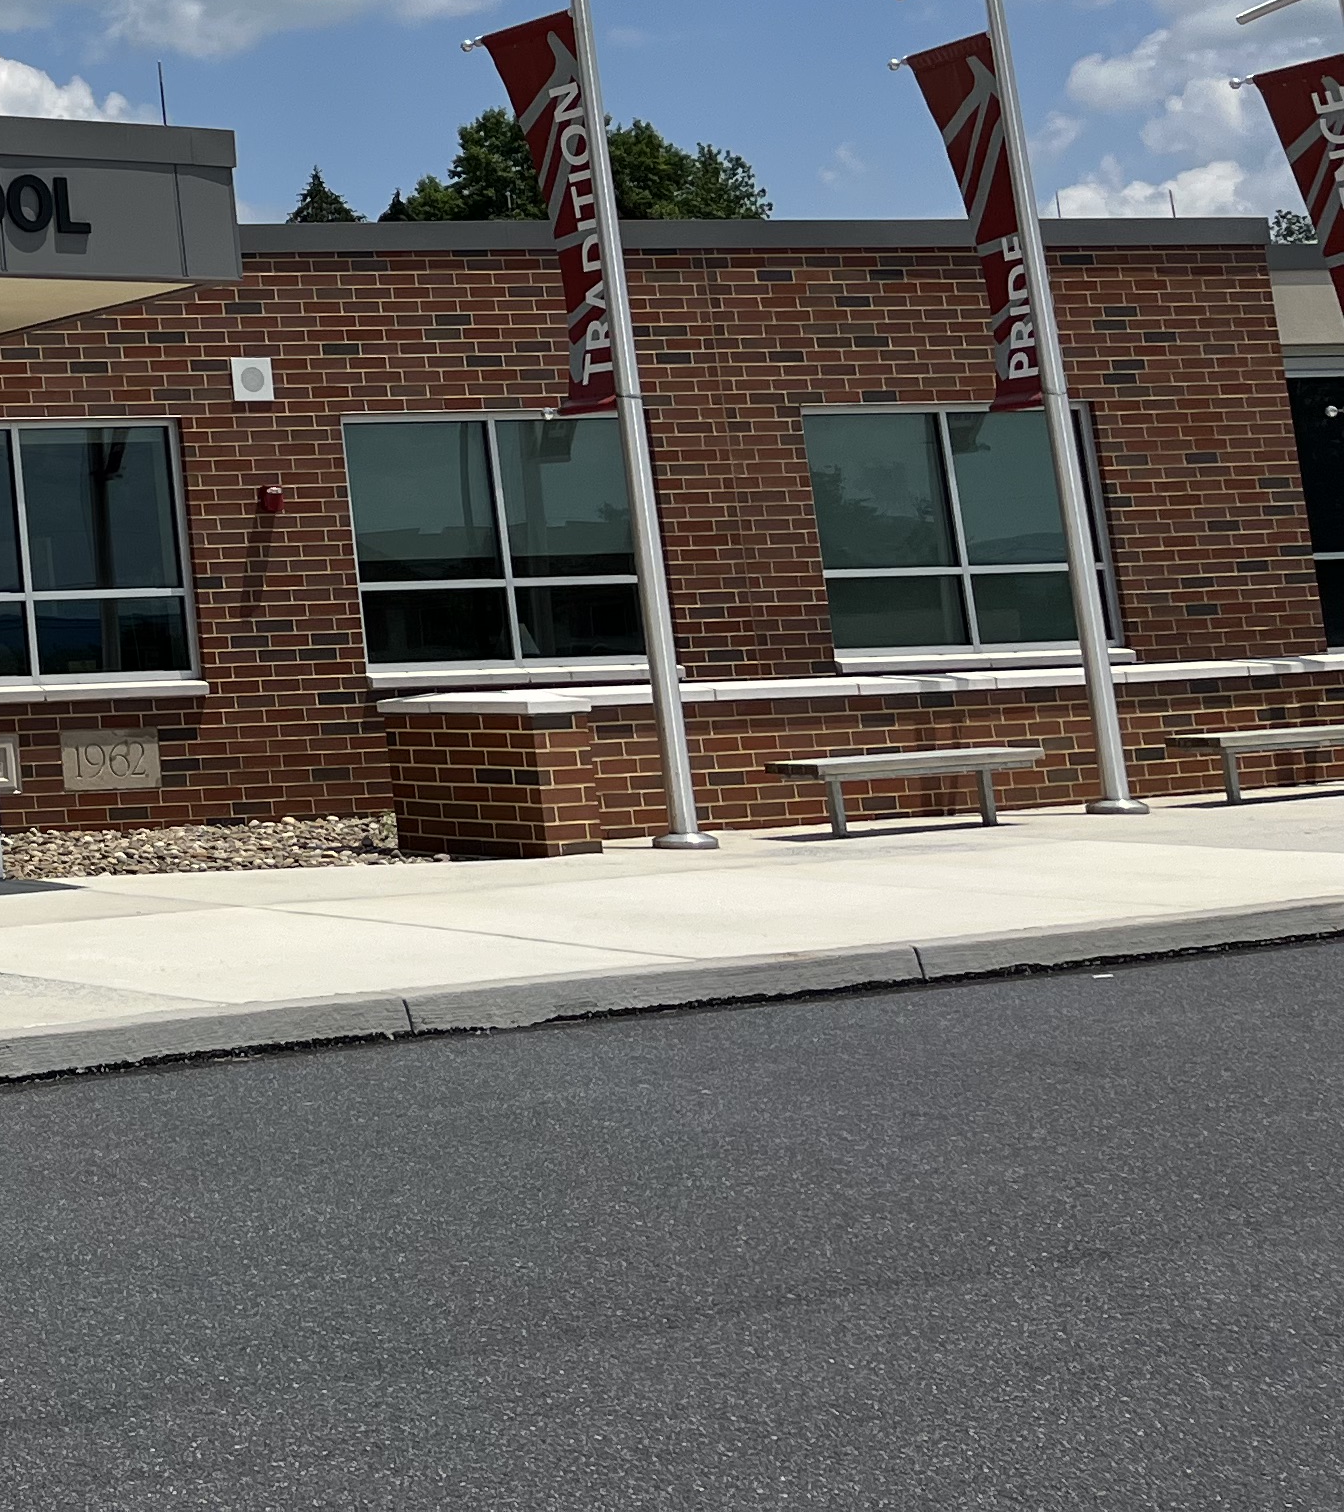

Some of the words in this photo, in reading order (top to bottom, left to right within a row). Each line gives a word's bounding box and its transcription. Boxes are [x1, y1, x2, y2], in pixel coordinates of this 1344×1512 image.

[548, 81, 613, 386] TRADITION
[1001, 236, 1039, 380] PRIDE
[73, 739, 146, 780] 1962
